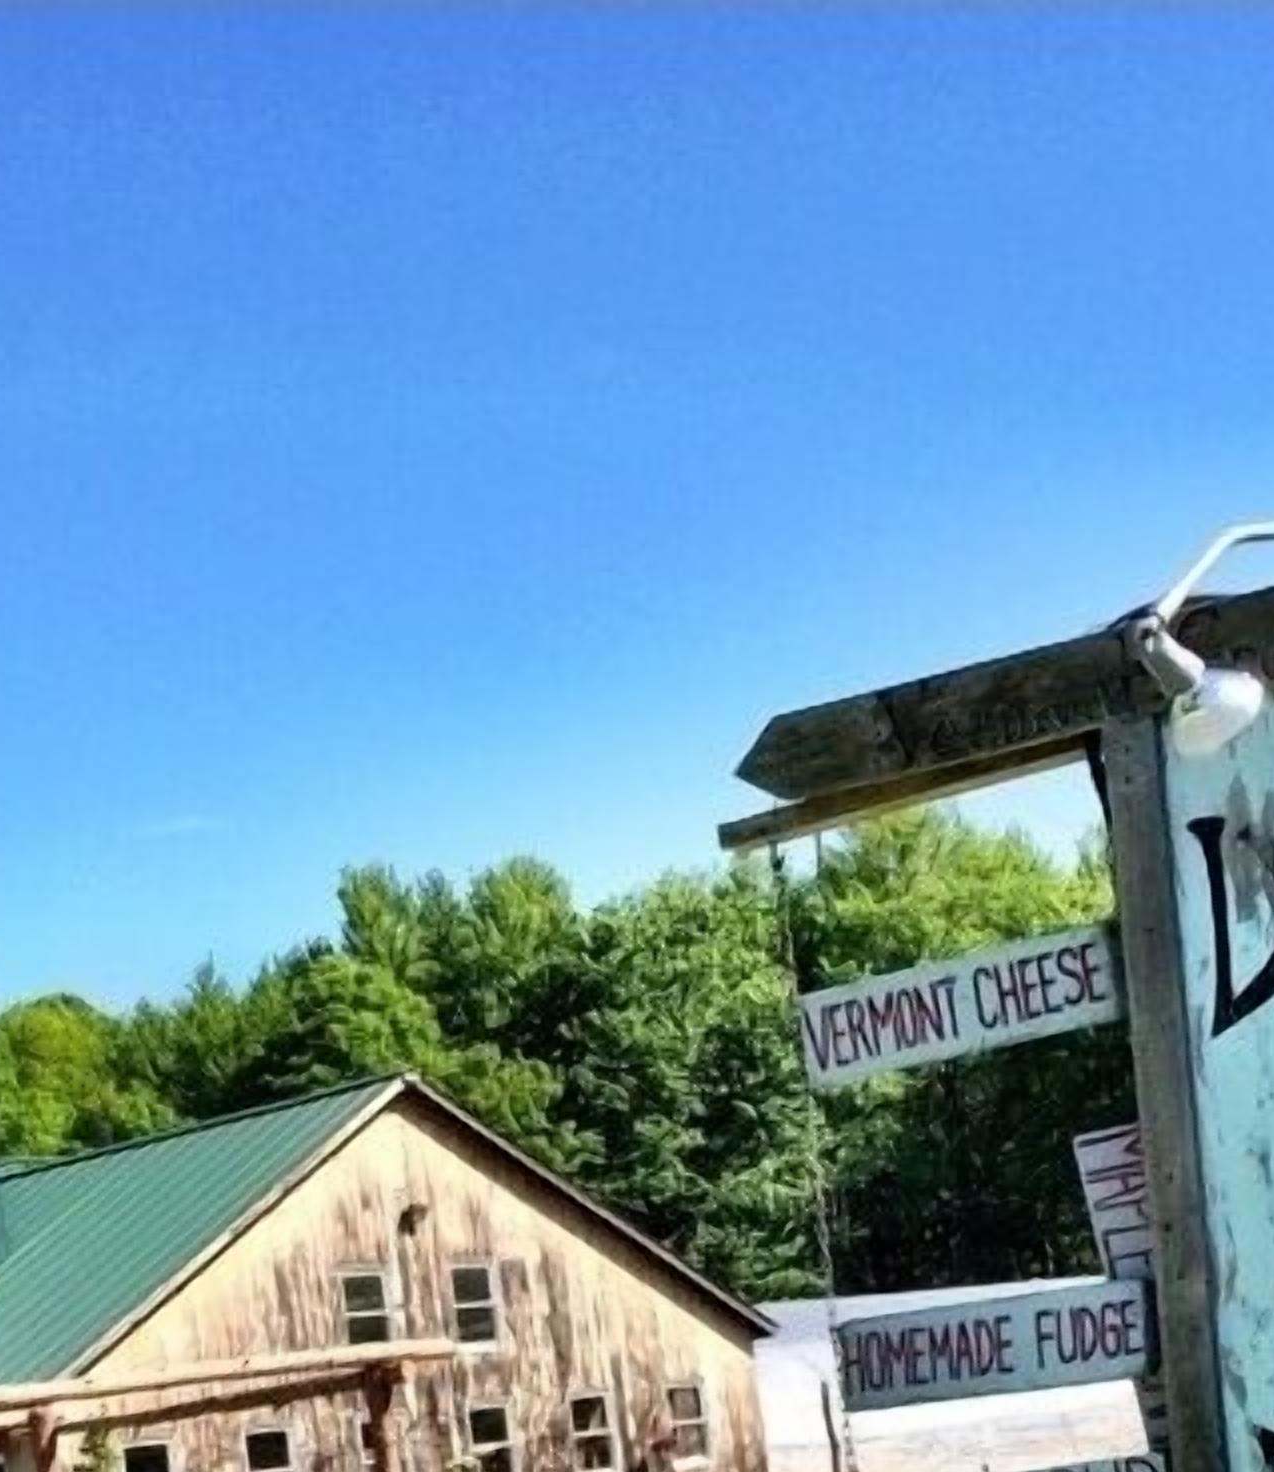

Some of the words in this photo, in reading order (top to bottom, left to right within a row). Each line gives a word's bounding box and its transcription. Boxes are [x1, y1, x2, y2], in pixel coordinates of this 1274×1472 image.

[804, 974, 961, 1071] VERMONT
[972, 943, 1107, 1029] CHEESE
[841, 1314, 1015, 1394] HOMEMADE
[1036, 1299, 1144, 1369] FUDGE
